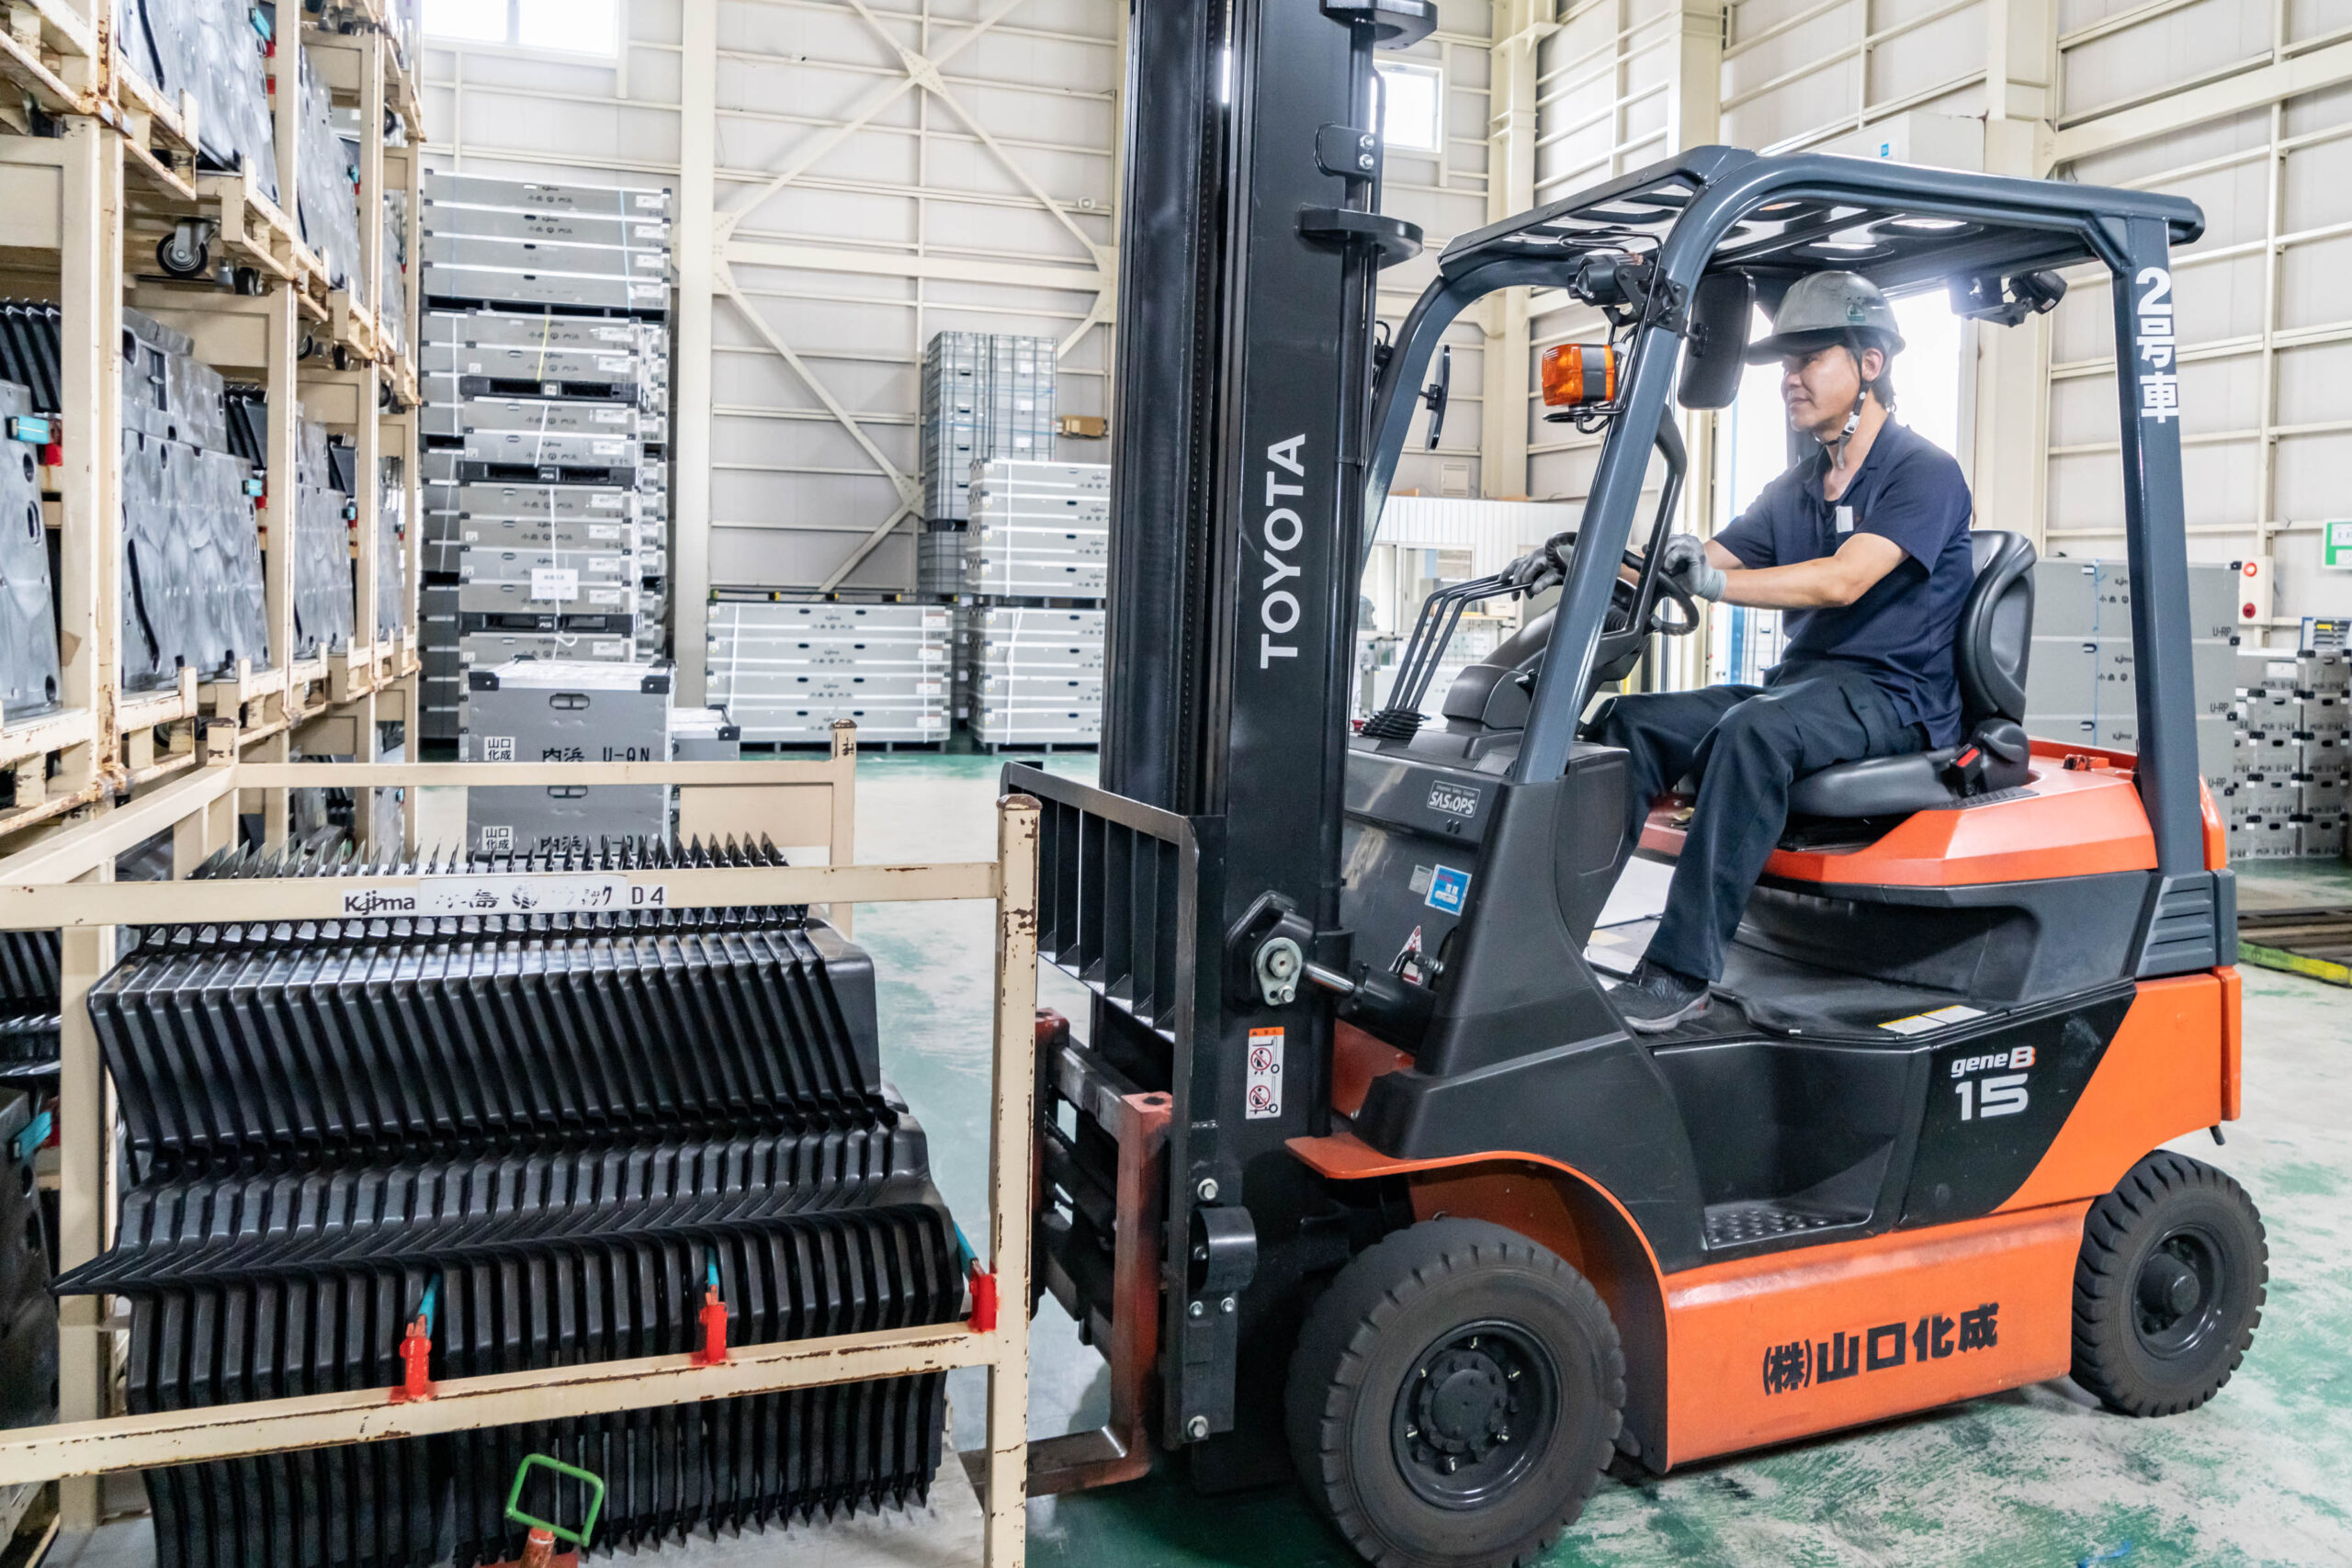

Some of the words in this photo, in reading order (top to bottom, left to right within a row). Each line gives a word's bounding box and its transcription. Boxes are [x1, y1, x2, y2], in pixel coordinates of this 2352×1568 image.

[2135, 266, 2178, 423] 2号車
[1260, 433, 1306, 669] TOYOTA
[488, 738, 512, 749] 山口
[488, 750, 512, 761] 化成
[486, 828, 509, 839] 山口
[486, 839, 510, 850] 化成
[1951, 1045, 2036, 1078] geneB
[1955, 1073, 2029, 1121] 15
